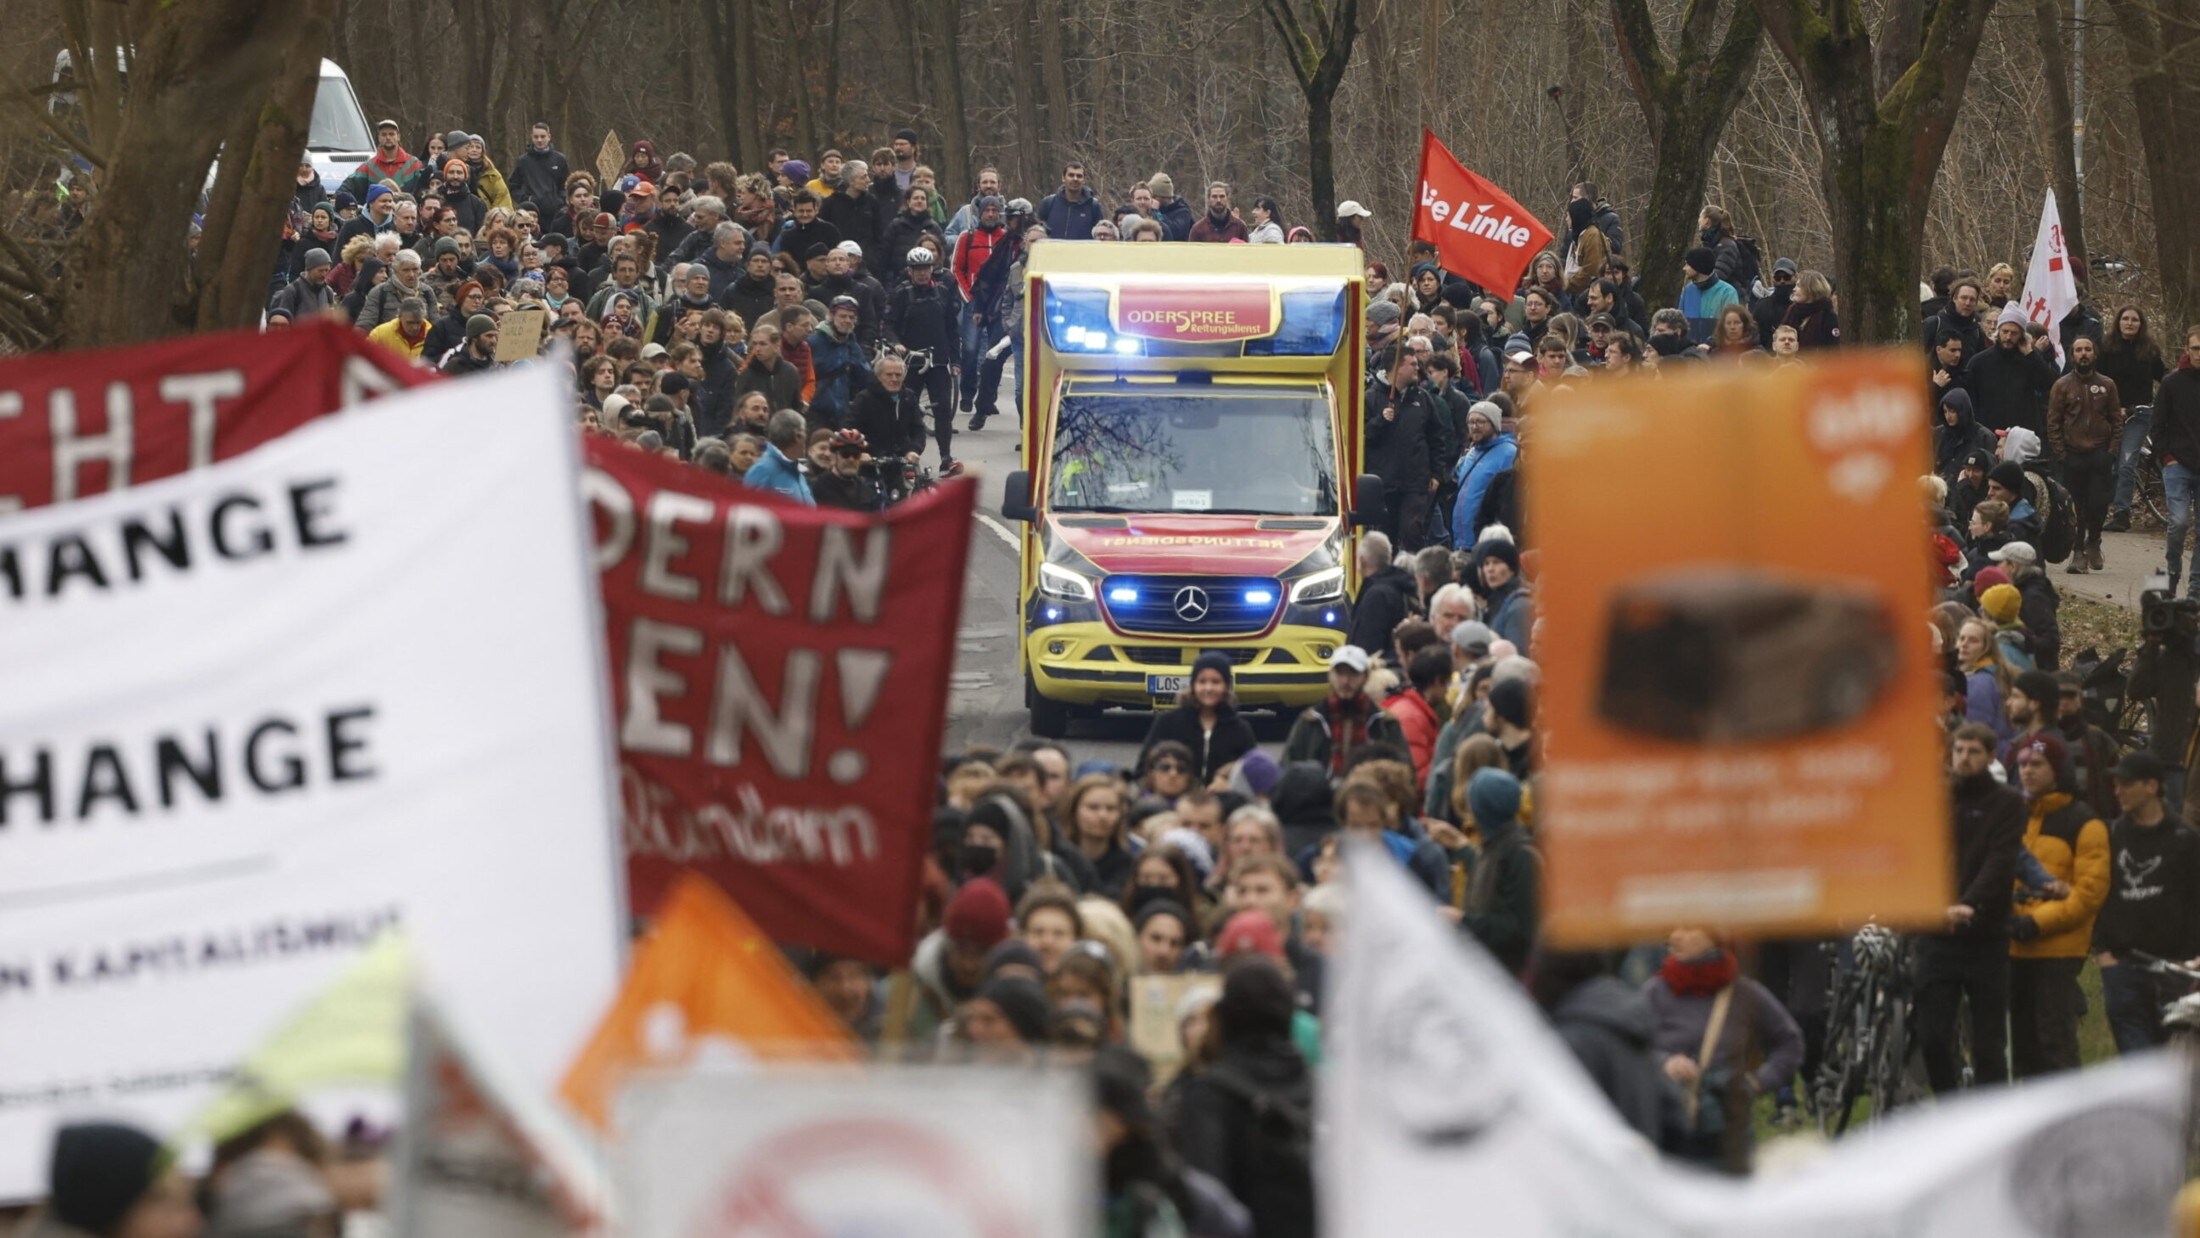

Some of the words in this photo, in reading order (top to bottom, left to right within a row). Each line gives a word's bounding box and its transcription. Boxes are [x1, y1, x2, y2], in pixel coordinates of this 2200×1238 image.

[1449, 201, 1531, 248] Linke
[1191, 324, 1261, 335] Rettungsdienst
[1156, 677, 1180, 691] LOS
